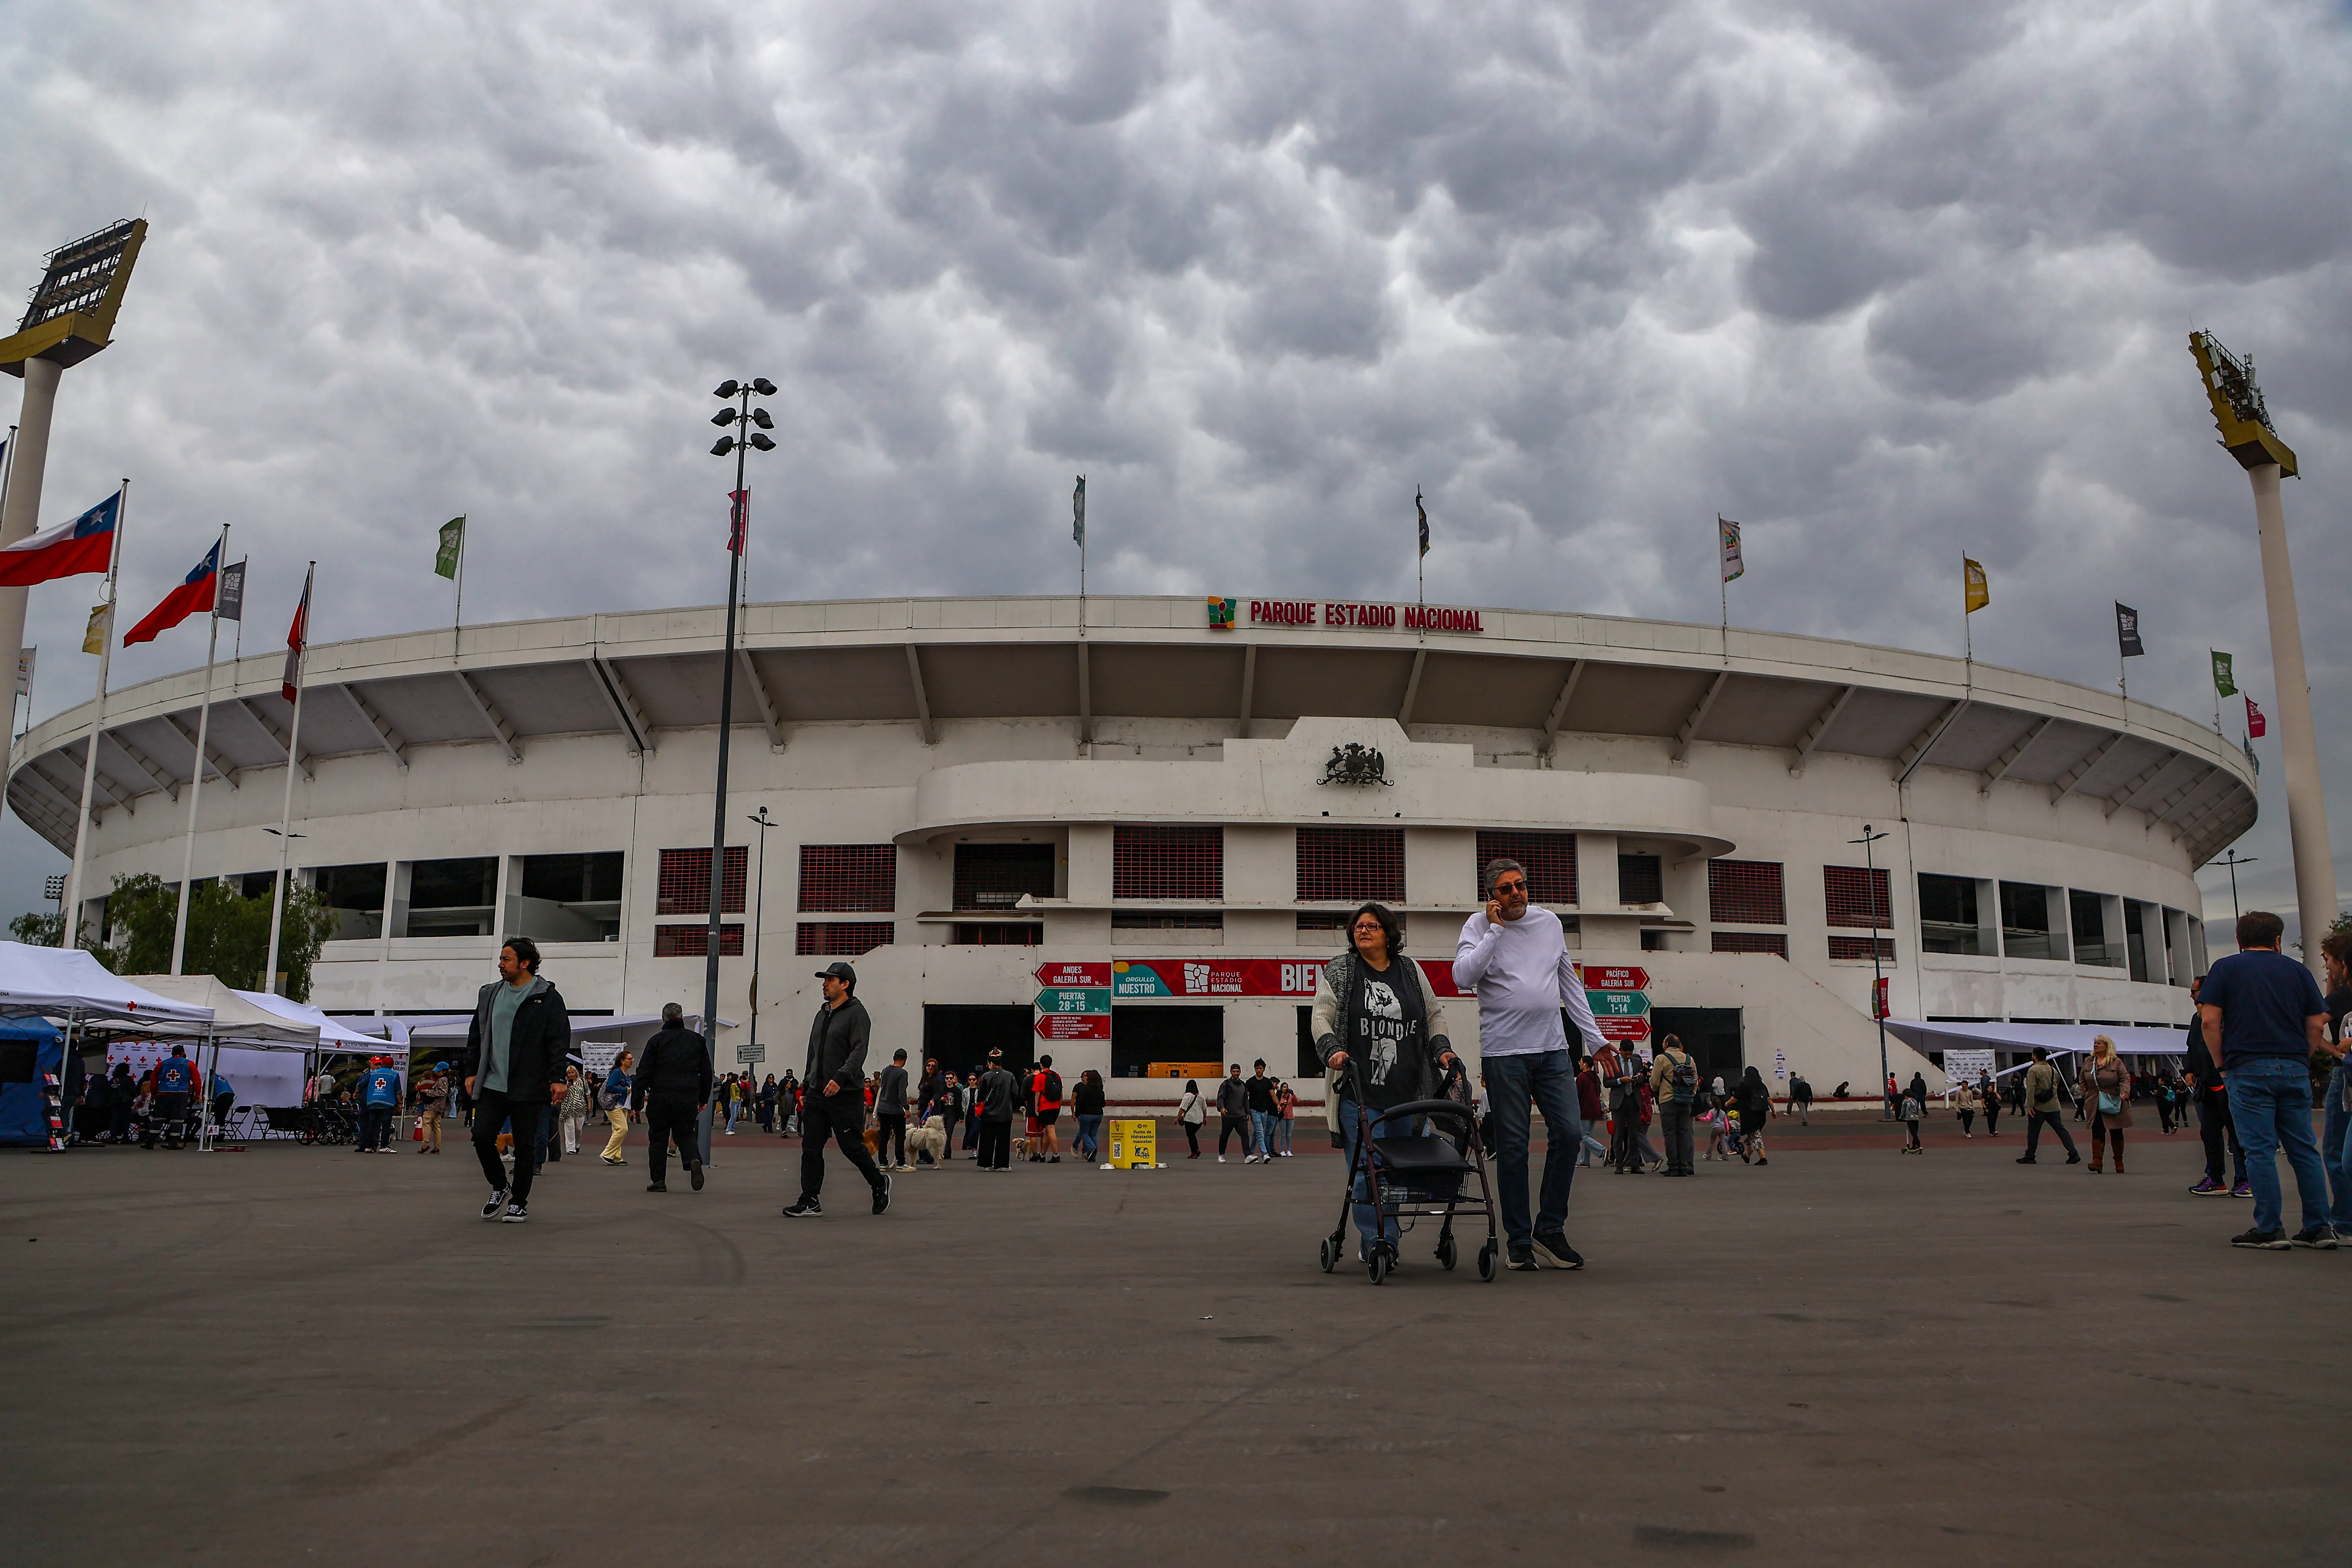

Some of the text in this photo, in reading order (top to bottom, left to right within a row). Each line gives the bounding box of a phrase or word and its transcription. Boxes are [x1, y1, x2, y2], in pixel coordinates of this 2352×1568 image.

[1251, 601, 1484, 632] PARQUE ESTADIO NACIONAL
[1606, 968, 1629, 977] PACÍFICO
[1053, 974, 1078, 983] GALERÍA
[1601, 978, 1623, 987] GALERÍA
[1119, 984, 1155, 993] NUESTRO
[1211, 984, 1243, 993] NACIONAL
[1059, 1001, 1085, 1011] 28-15
[1610, 1004, 1628, 1013] 1-14
[1360, 1018, 1417, 1040] BLONDIE
